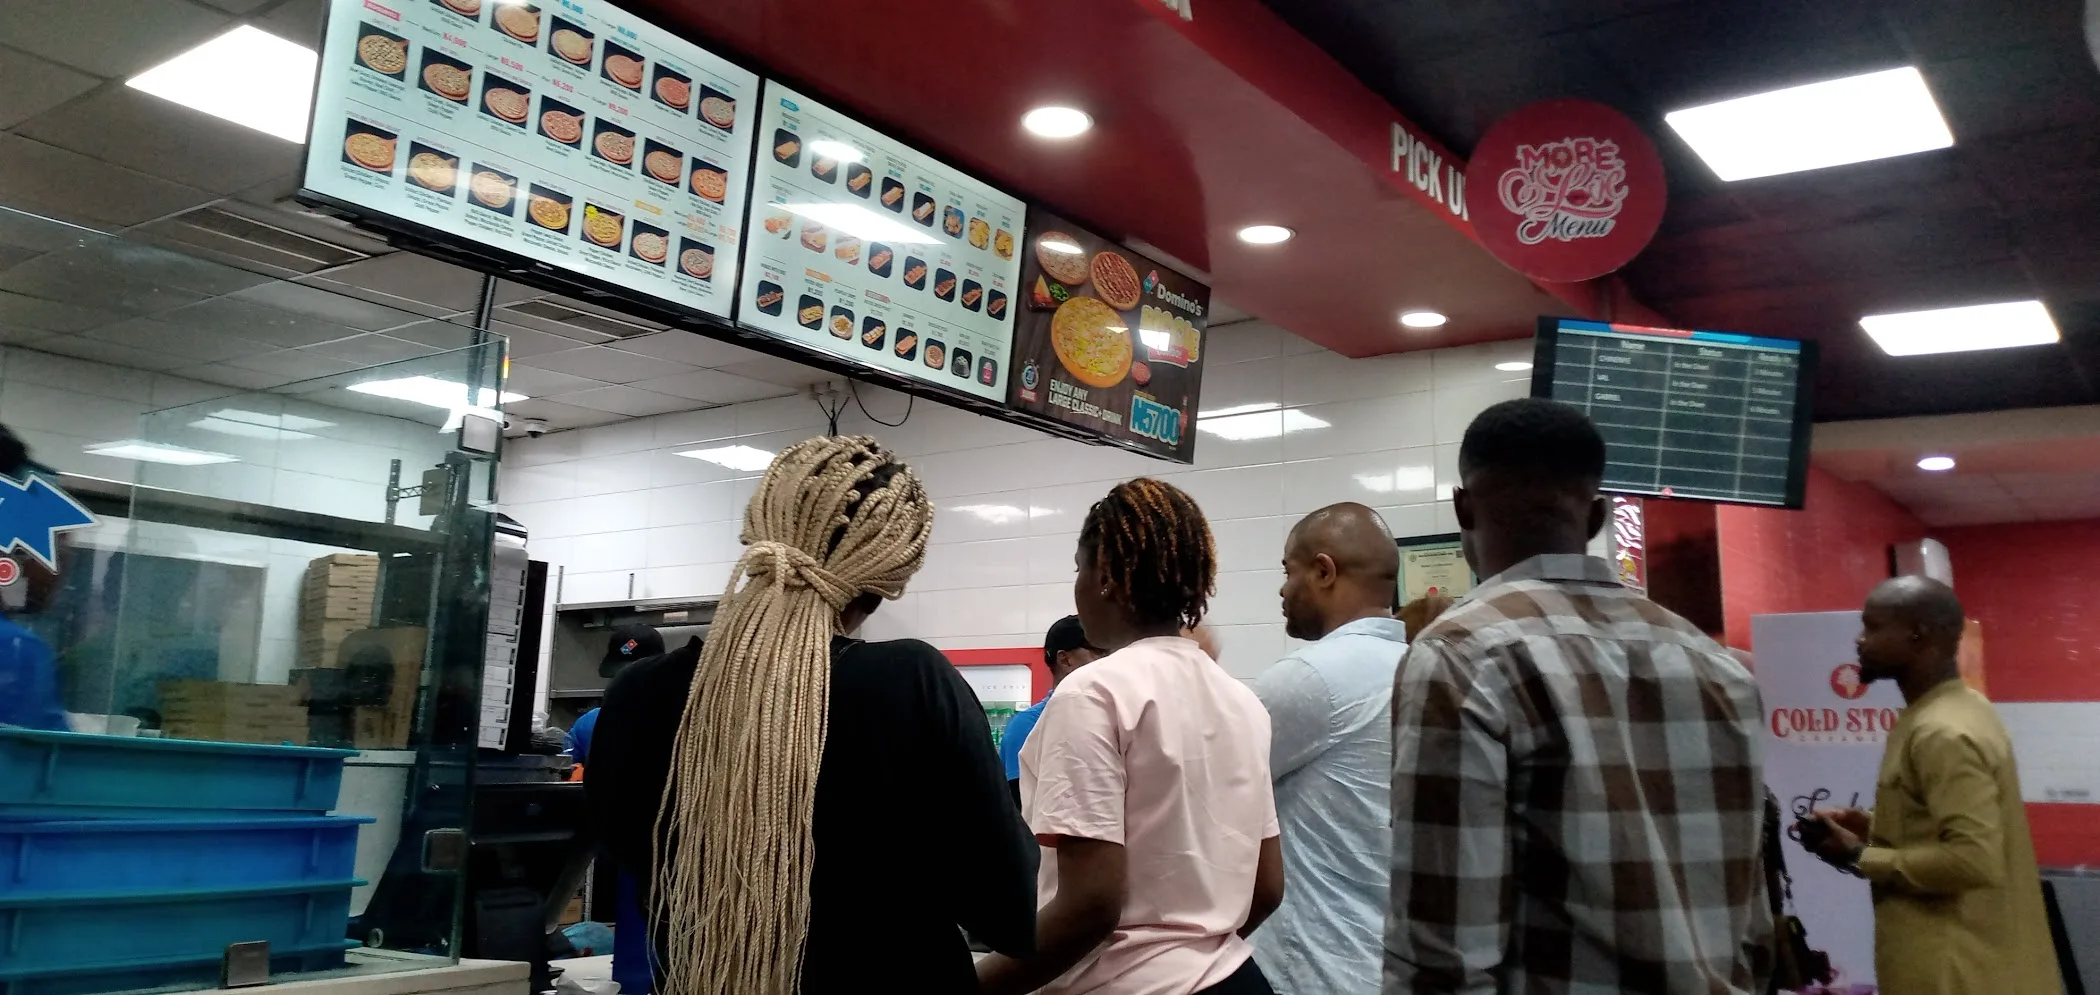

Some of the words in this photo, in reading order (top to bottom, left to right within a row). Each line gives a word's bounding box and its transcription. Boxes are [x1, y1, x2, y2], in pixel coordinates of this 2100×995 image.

[1391, 121, 1443, 204] PICK
[1516, 138, 1624, 173] MORE
[1517, 213, 1614, 244] Menu
[1156, 283, 1202, 316] Domino's
[1050, 378, 1073, 397] ENJOY
[1072, 384, 1088, 401] ANY
[1771, 708, 1840, 738] COLD
[1846, 708, 1904, 733] STO
